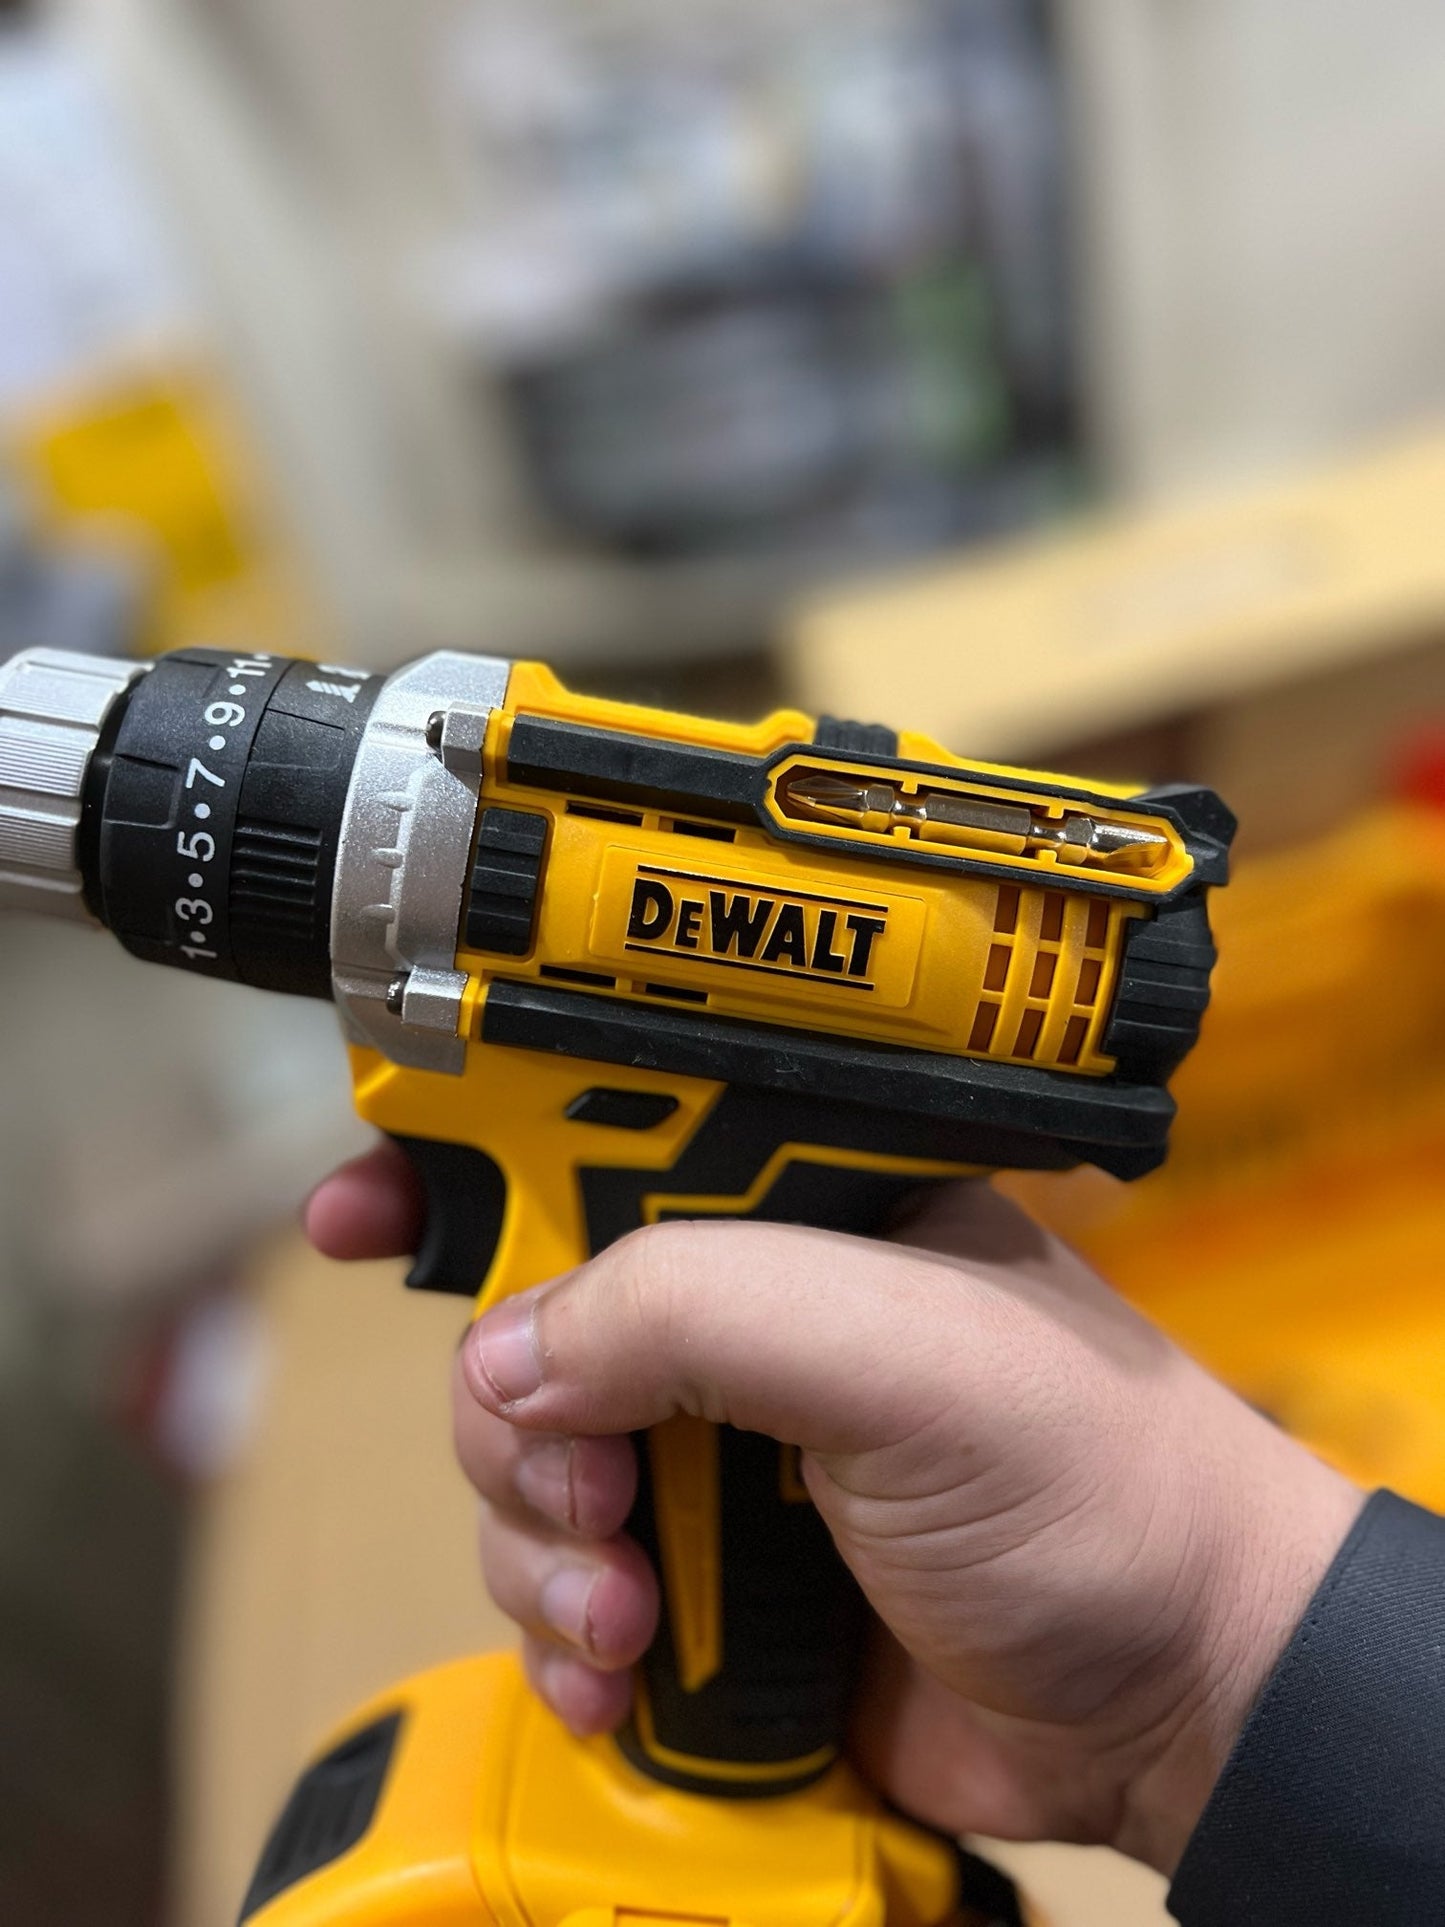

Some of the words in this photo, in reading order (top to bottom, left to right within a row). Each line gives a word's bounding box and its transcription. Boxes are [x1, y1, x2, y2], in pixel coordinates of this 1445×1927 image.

[204, 701, 246, 727] 9
[186, 758, 226, 789] 7
[177, 831, 216, 863] 5
[175, 897, 214, 926] 3
